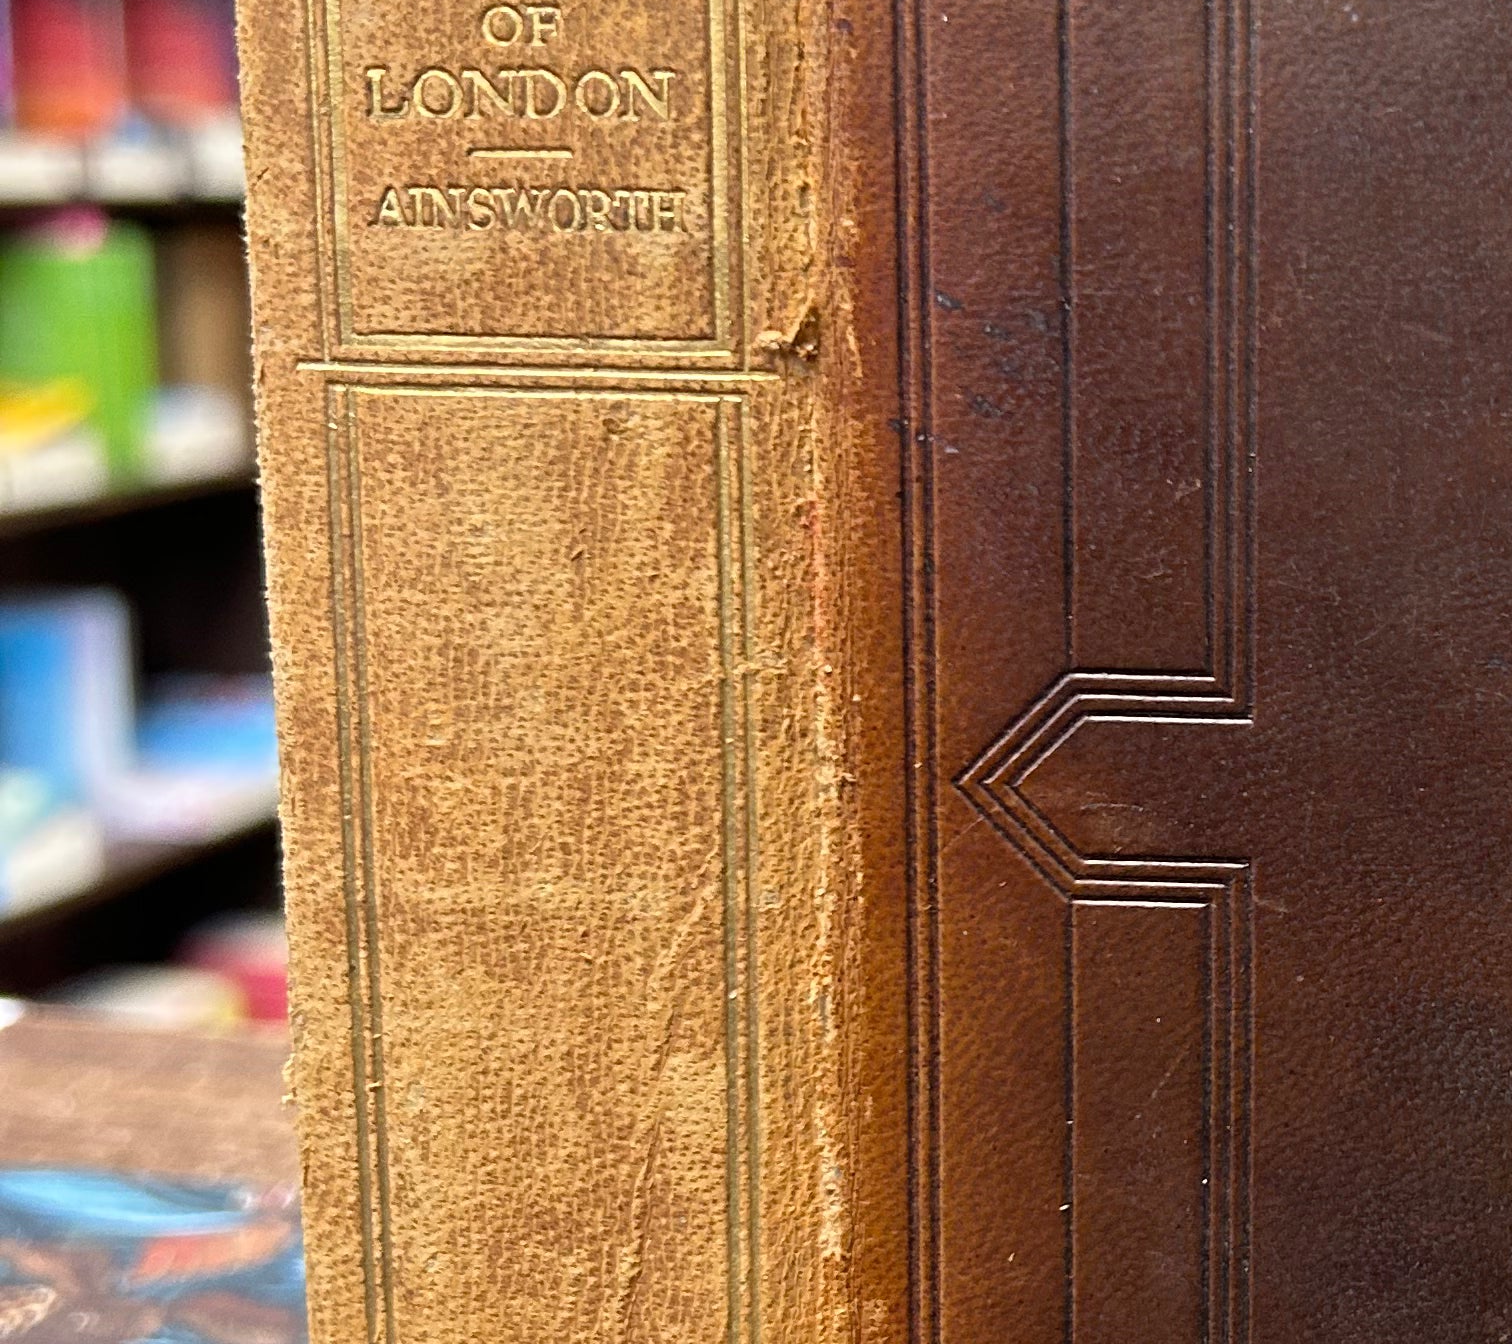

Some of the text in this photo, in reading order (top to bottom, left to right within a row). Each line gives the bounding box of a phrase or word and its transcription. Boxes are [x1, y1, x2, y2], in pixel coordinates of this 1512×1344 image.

[482, 5, 563, 48] OF
[366, 68, 675, 122] LONDON
[371, 187, 688, 234] AINSWORTH
